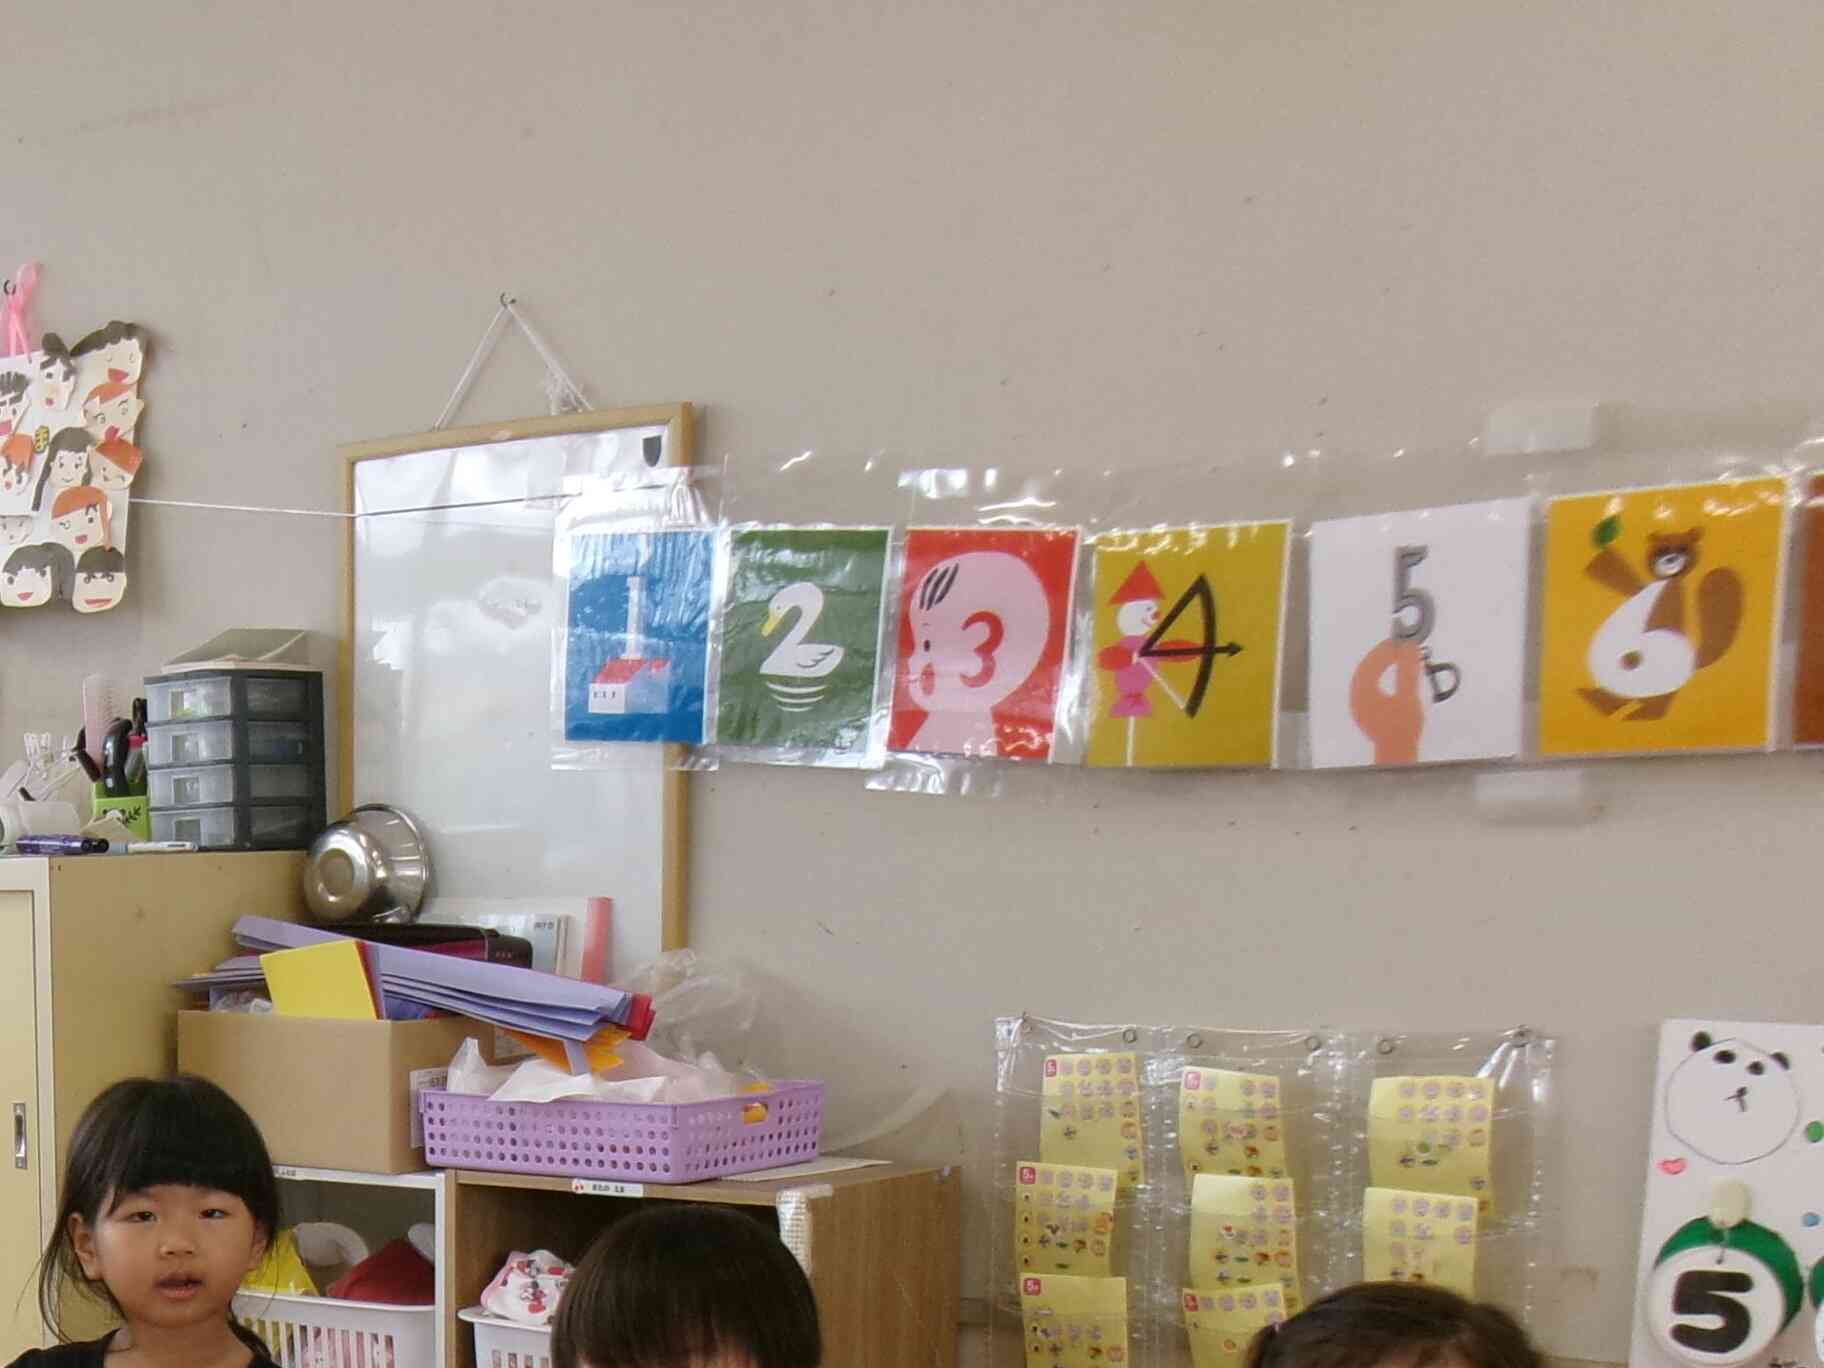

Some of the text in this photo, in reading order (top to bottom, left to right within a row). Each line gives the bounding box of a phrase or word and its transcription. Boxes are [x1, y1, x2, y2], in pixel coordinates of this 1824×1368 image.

[960, 611, 1004, 688] 3
[1587, 580, 1697, 699] 6
[1670, 1270, 1754, 1354] 5
